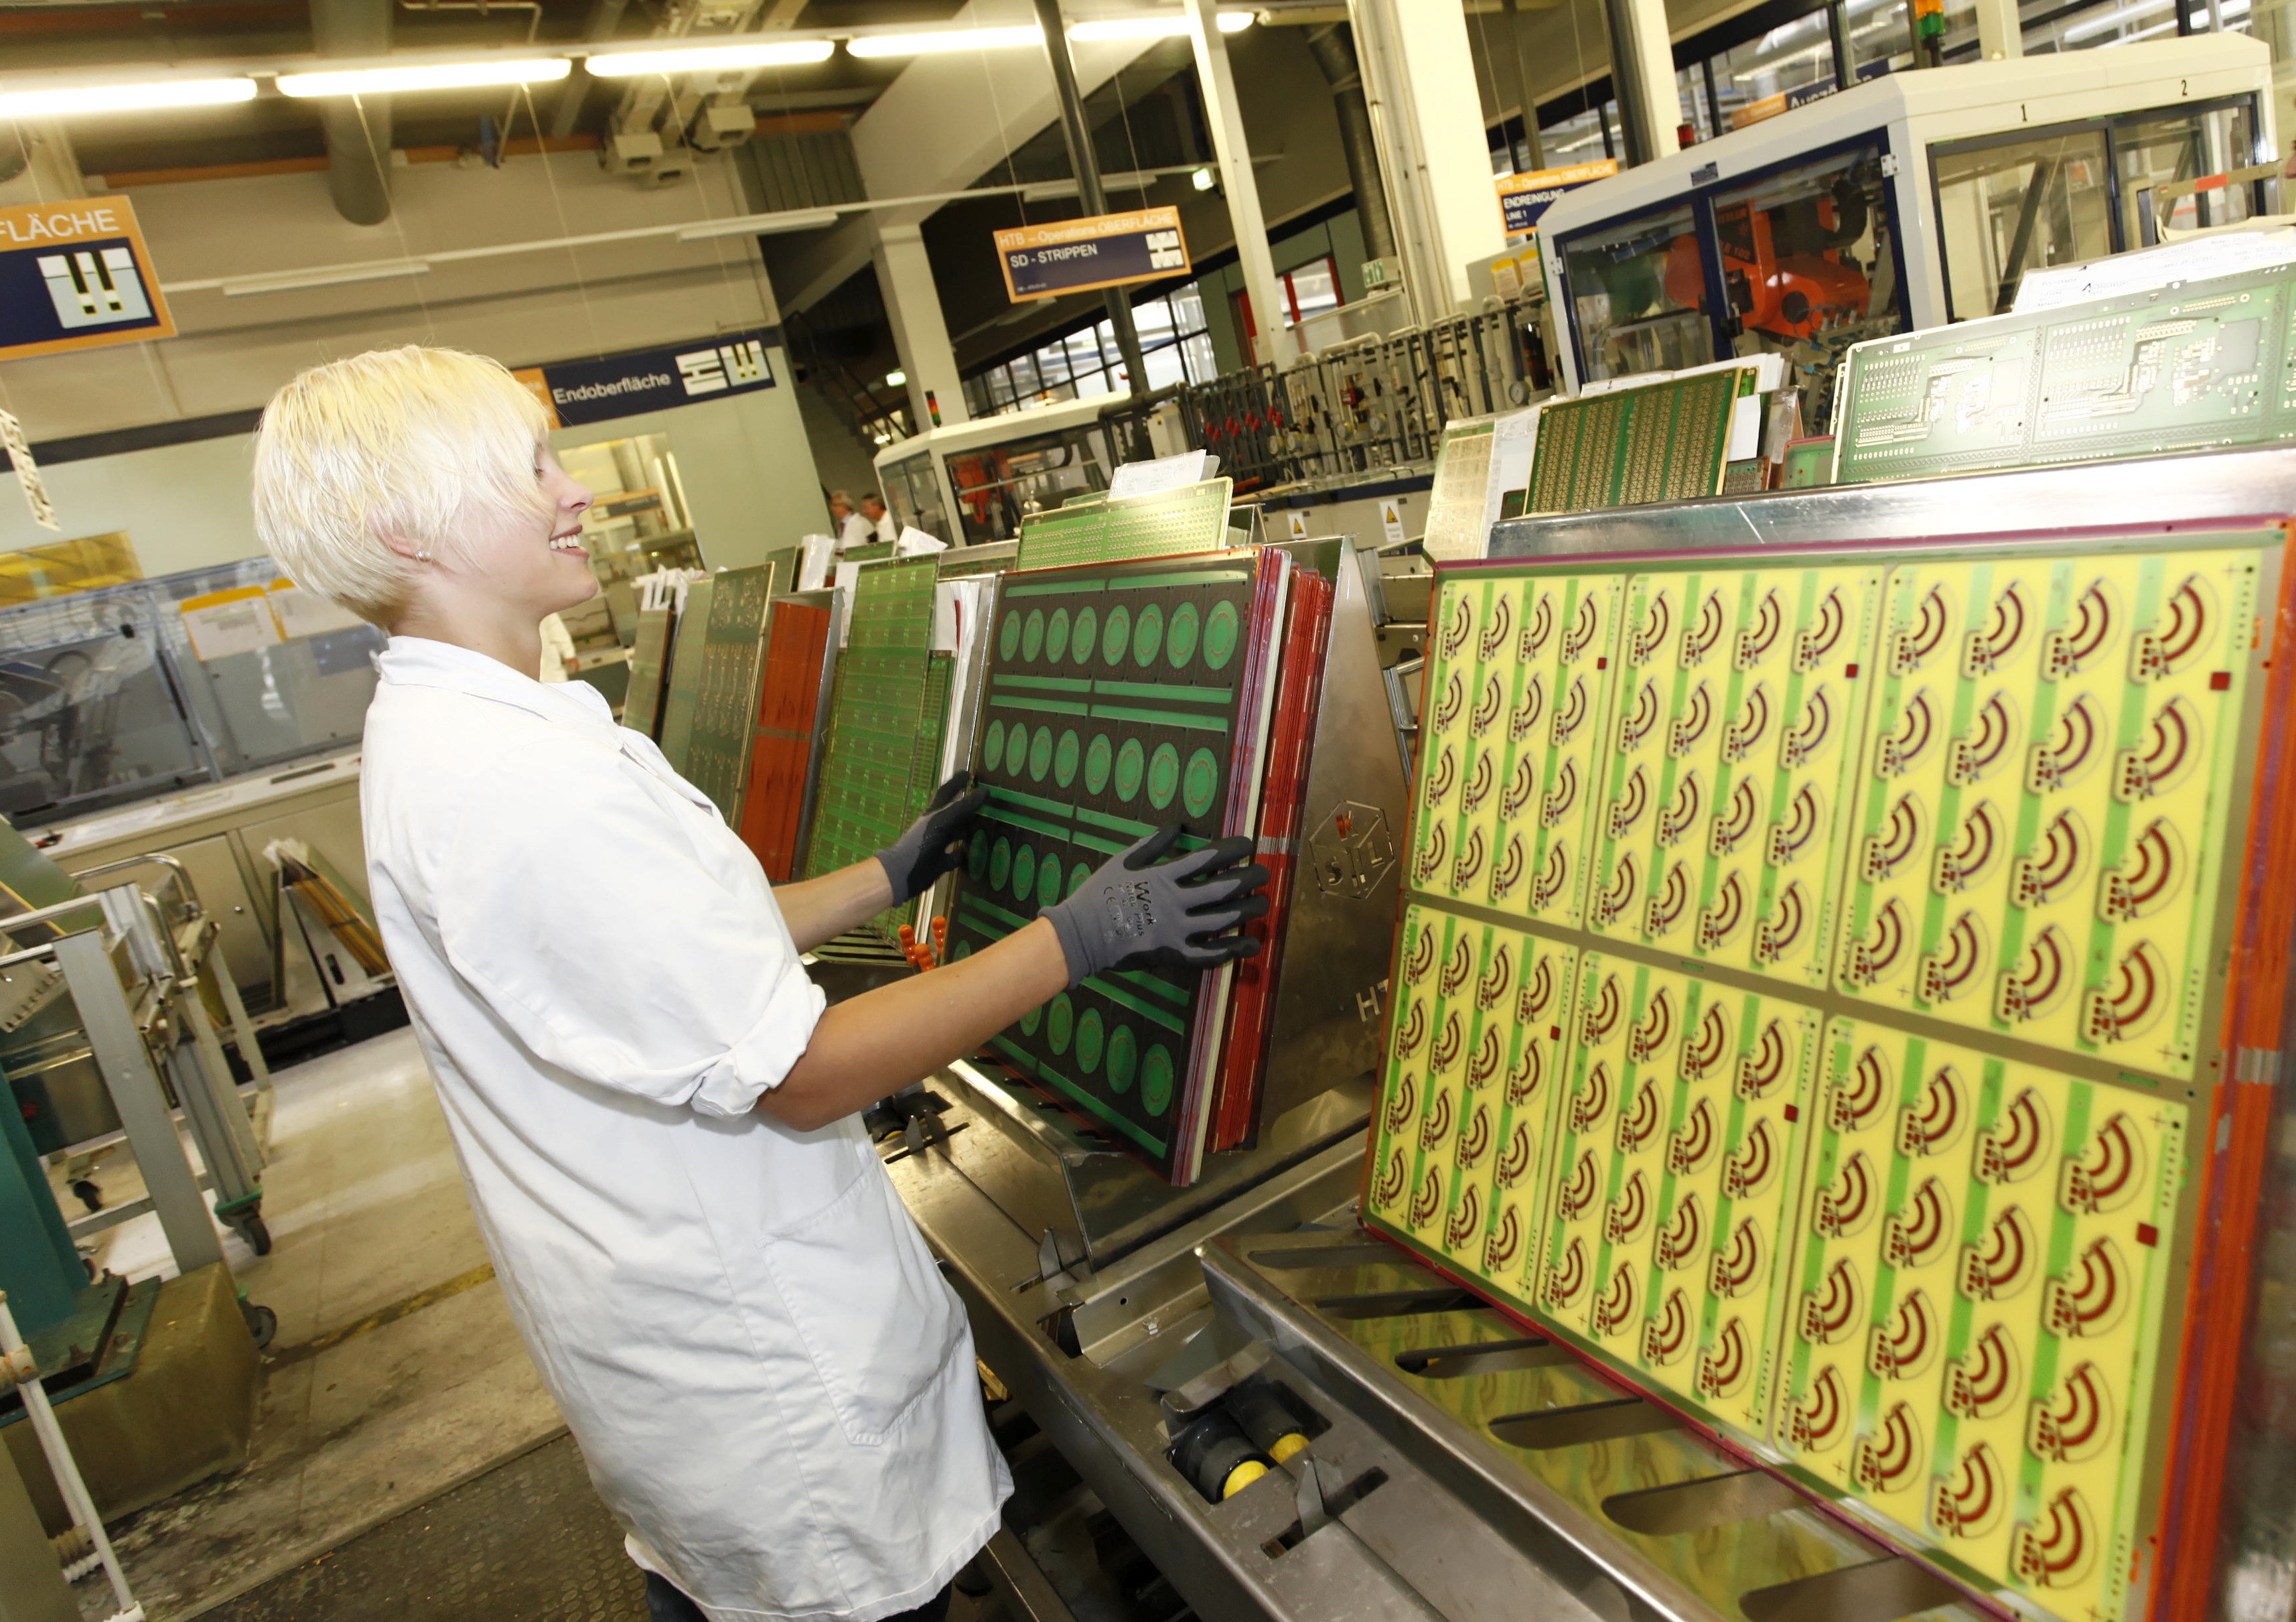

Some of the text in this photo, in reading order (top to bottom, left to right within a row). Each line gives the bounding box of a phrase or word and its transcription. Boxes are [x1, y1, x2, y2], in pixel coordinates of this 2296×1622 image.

[2181, 79, 2188, 96] 2
[2021, 103, 2027, 122] 1
[999, 232, 1025, 247] HTB
[1038, 226, 1096, 244] Operations
[1098, 212, 1175, 234] OBERFLÄCHE
[1009, 254, 1029, 269] SD
[1038, 243, 1098, 264] STRIPPEN
[553, 373, 672, 405] Endoberfläche
[1134, 881, 1155, 925] Work
